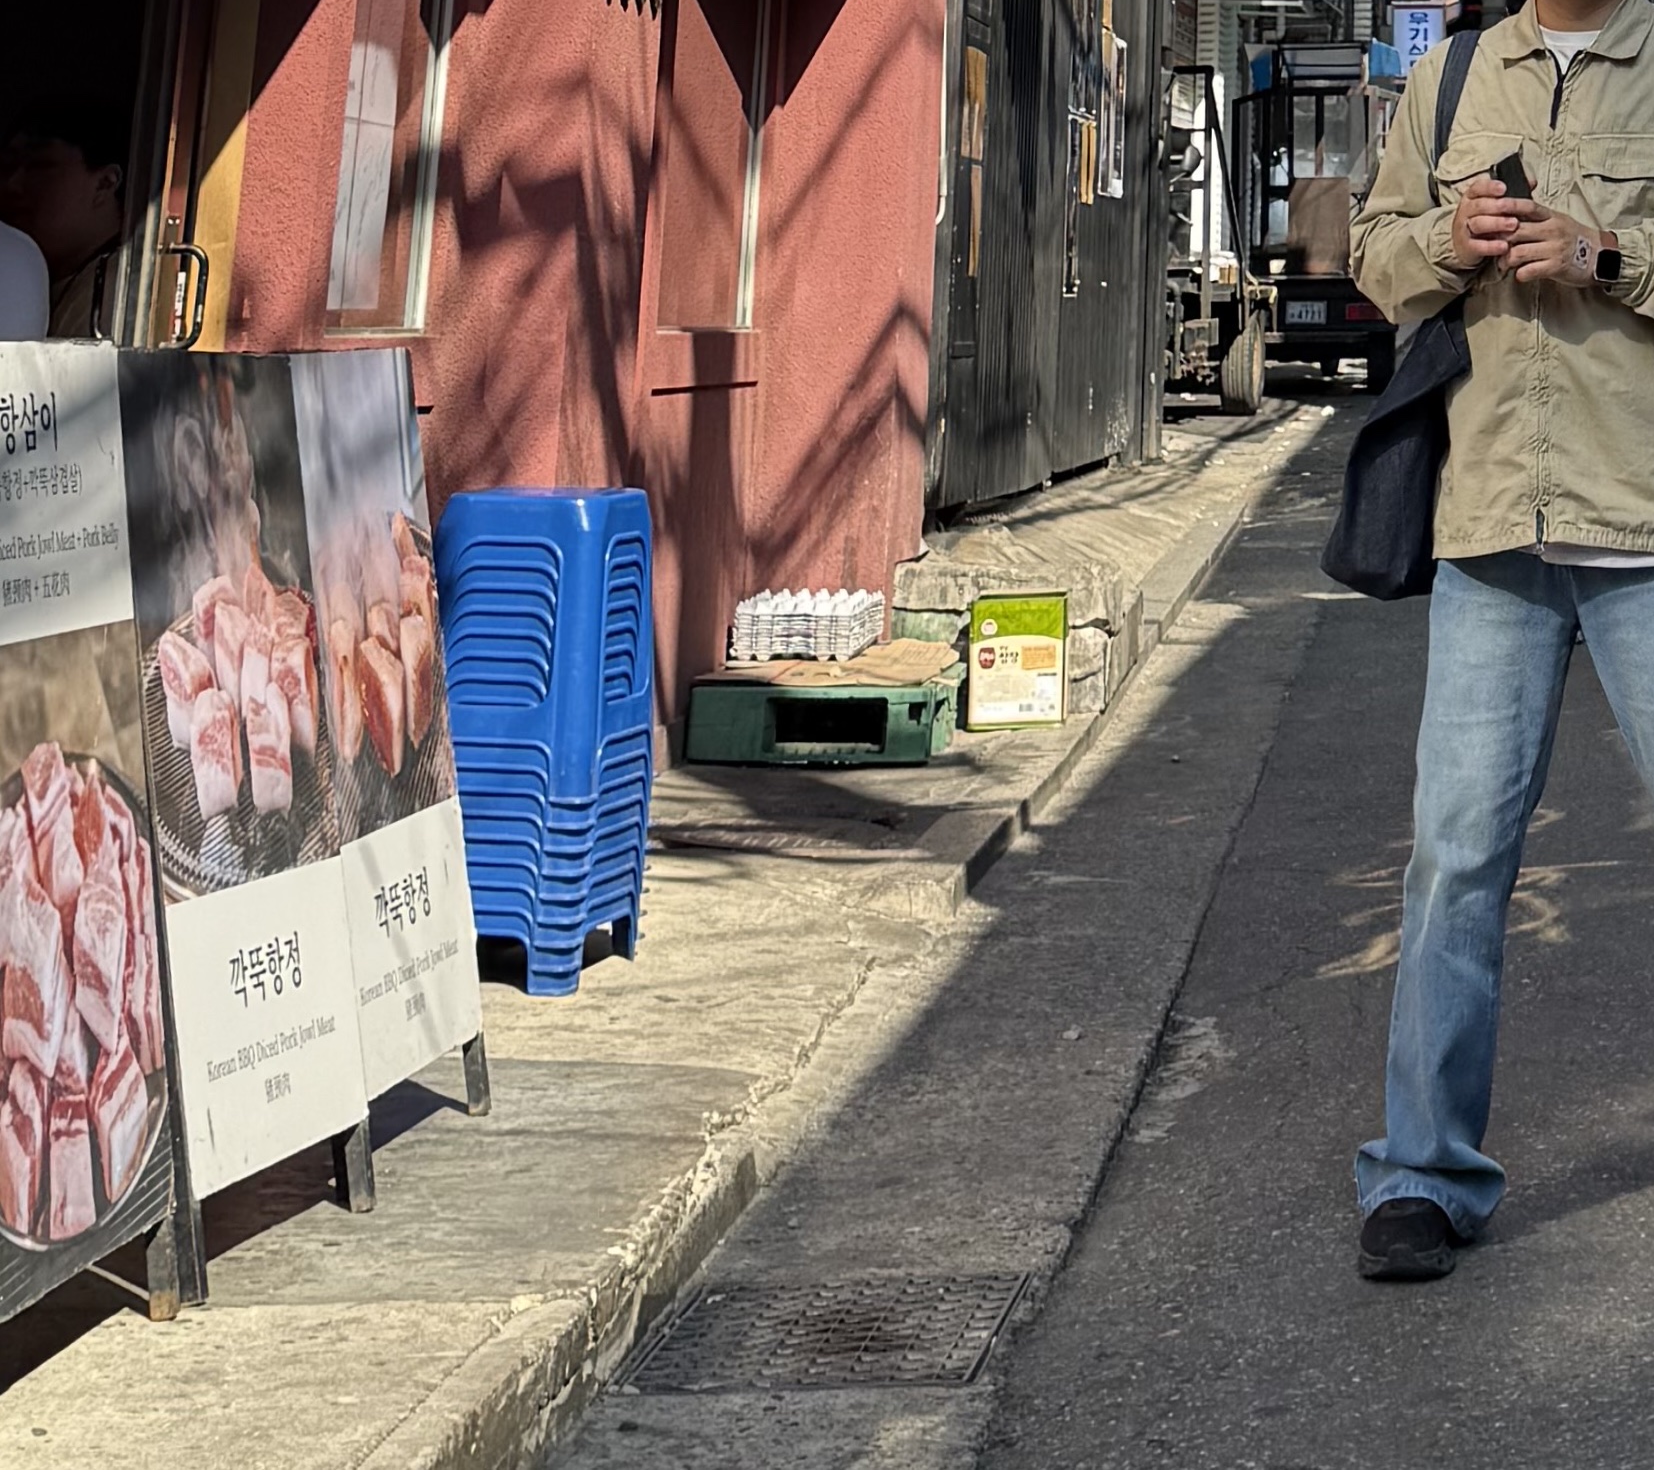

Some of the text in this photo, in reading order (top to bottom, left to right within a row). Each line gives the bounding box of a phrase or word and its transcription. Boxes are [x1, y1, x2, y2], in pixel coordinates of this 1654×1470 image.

[229, 931, 303, 1008] 깍뚝항정
[206, 1057, 237, 1083] Korean
[237, 1044, 256, 1070] BBQ
